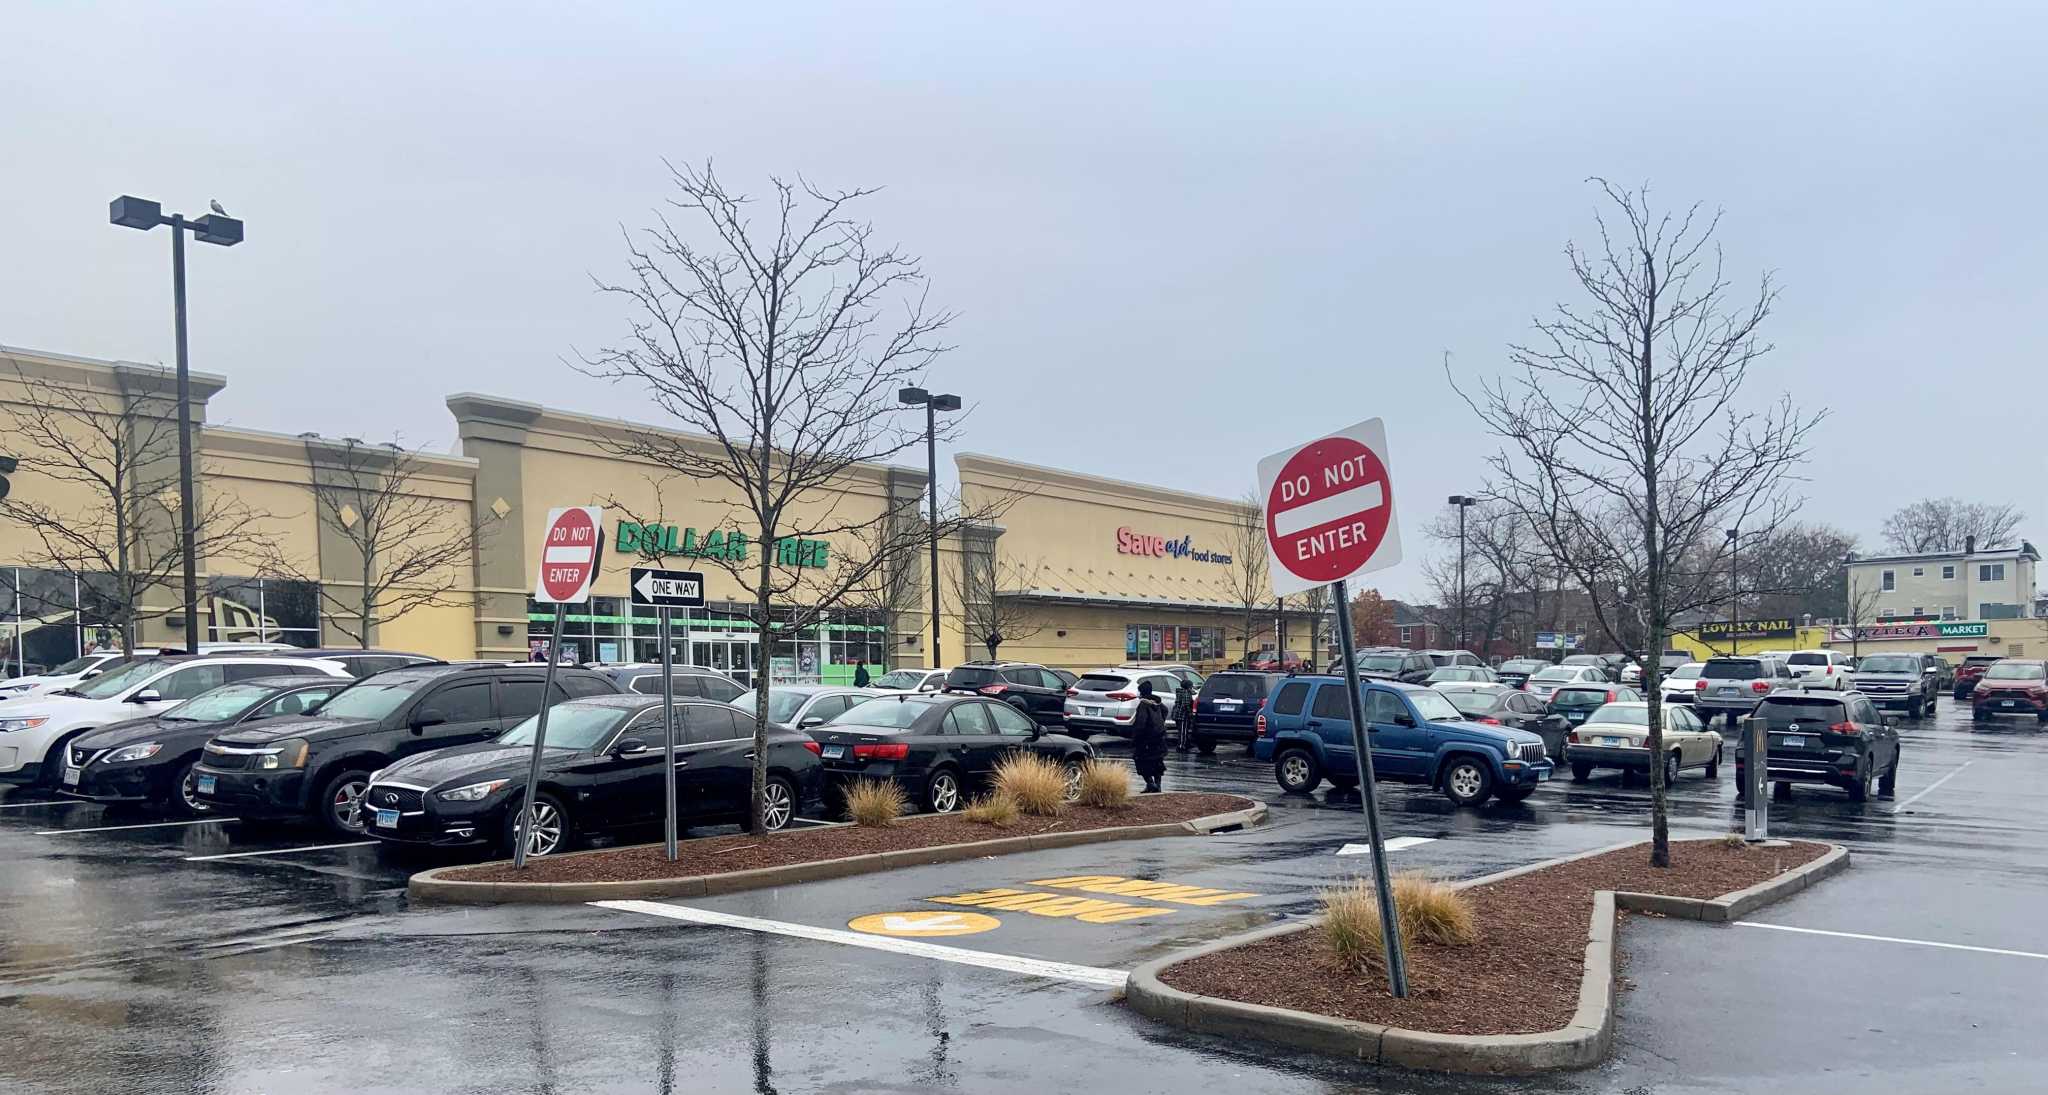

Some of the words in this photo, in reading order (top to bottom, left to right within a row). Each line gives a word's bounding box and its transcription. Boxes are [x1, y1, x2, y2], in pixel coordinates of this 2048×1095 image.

[1281, 475, 1310, 502] DO
[1324, 454, 1366, 488] NOT
[553, 527, 567, 541] DO
[571, 527, 591, 541] NOT
[1296, 521, 1367, 560] ENTER
[616, 520, 748, 561] DOLLAR
[768, 536, 831, 569] REE
[1117, 526, 1165, 558] Save
[1191, 548, 1209, 562] food
[1210, 552, 1232, 565] stores
[549, 568, 579, 583] ENTER
[652, 579, 672, 595] ONE
[674, 580, 697, 596] WAY
[1702, 622, 1753, 633] LOVELY
[1757, 620, 1792, 631] NAIL
[1857, 626, 1929, 637] AZTECA
[1942, 624, 1985, 635] MARKET
